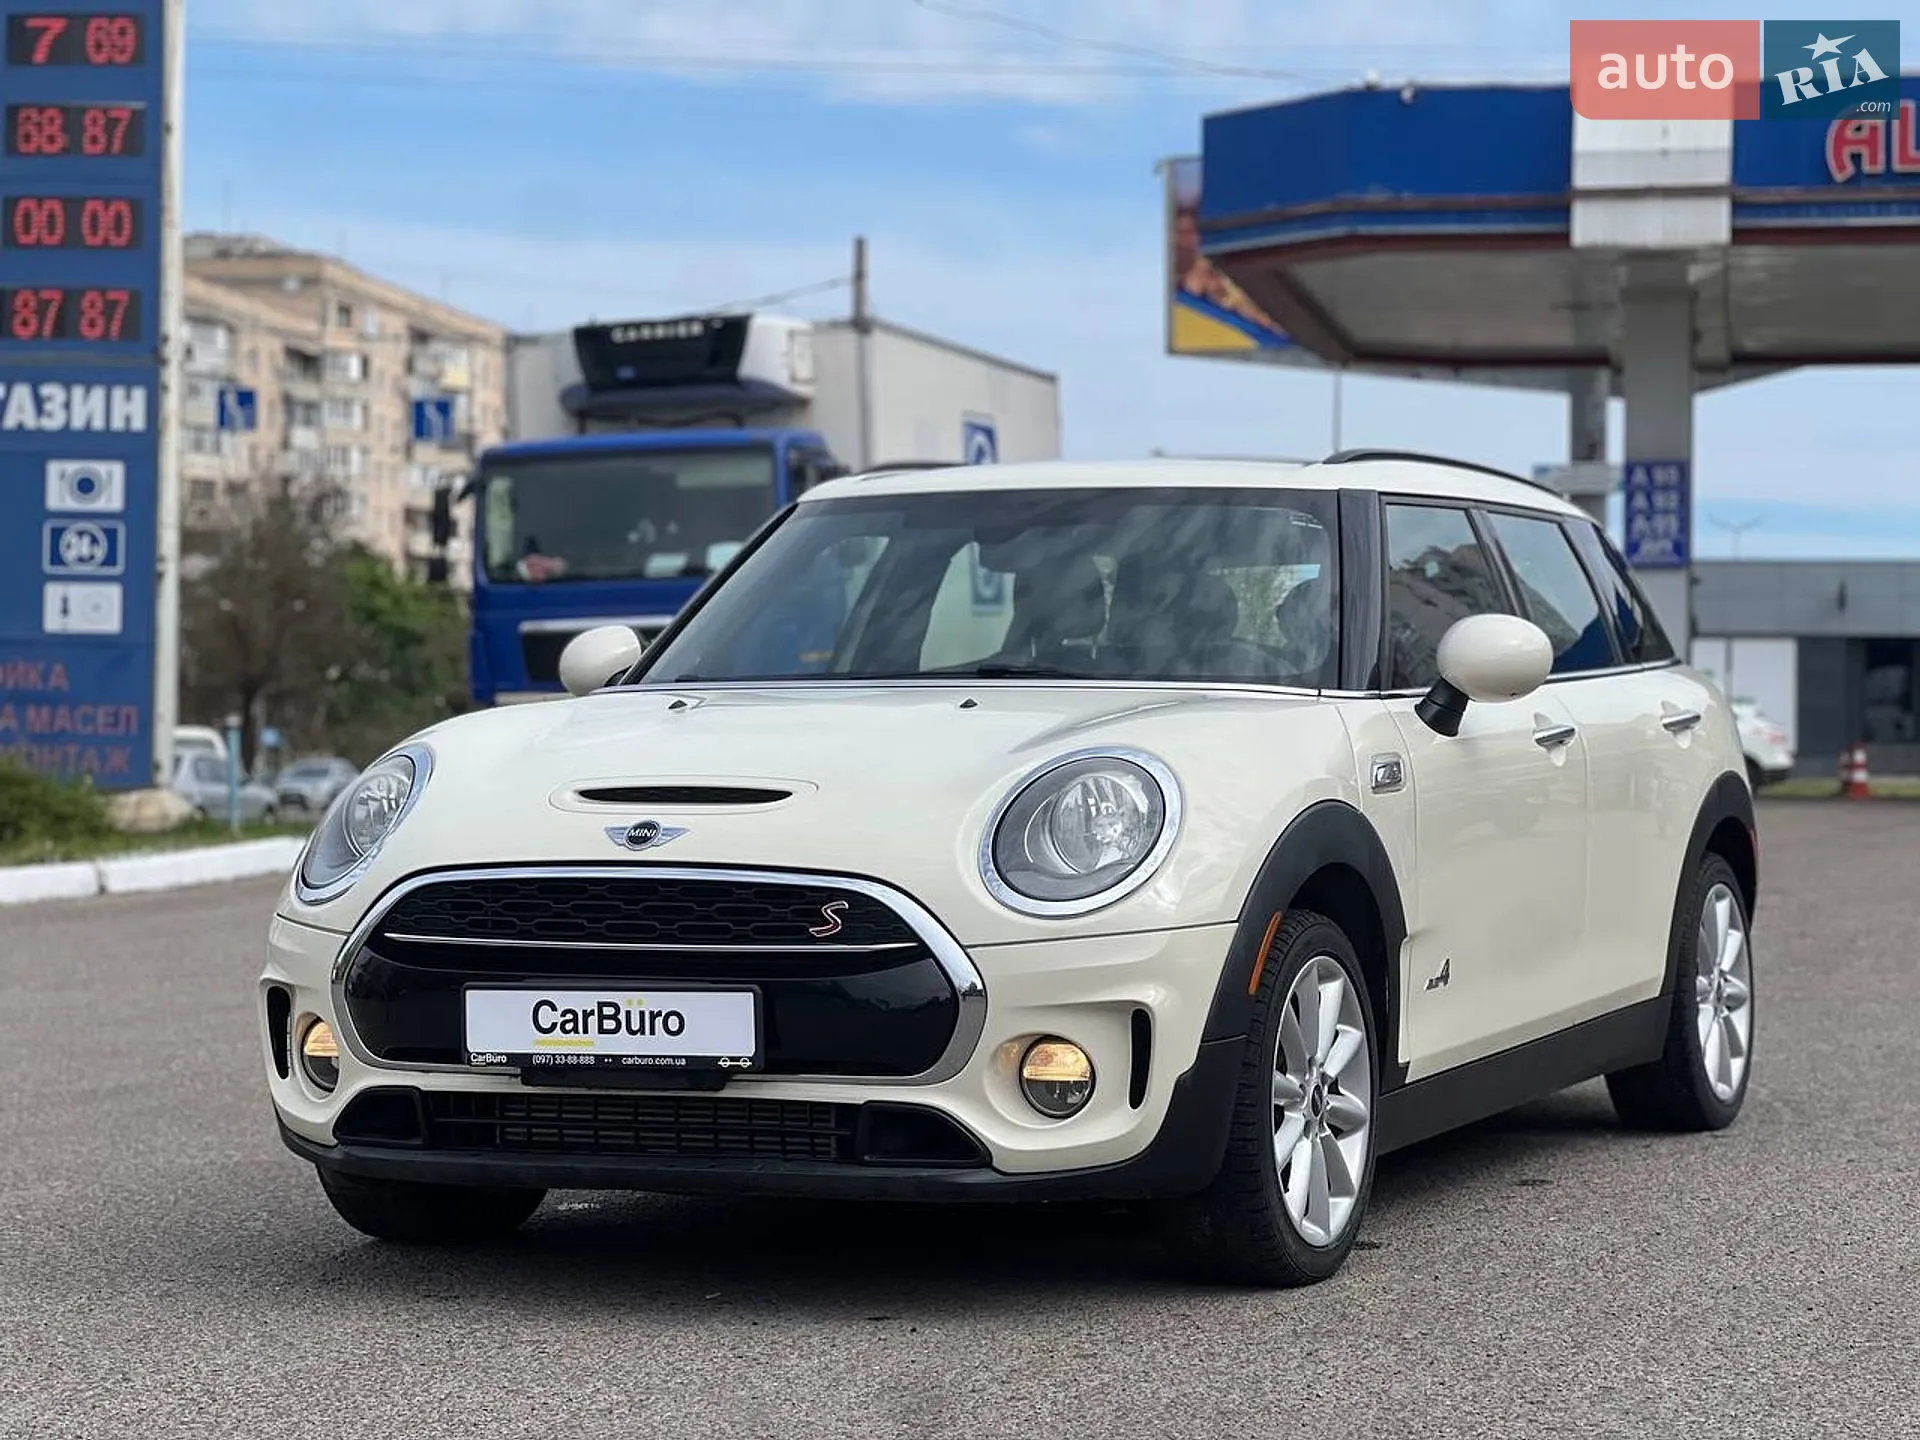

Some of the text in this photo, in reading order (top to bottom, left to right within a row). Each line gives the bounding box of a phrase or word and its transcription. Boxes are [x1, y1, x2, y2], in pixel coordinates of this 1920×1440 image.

[25, 17, 136, 64] 7 69
[82, 107, 132, 154] 87
[14, 198, 133, 247] 00 00
[12, 289, 130, 340] 87 87
[0, 382, 147, 433] АЗИН
[628, 828, 657, 837] MINI
[809, 900, 849, 937] S
[532, 998, 685, 1037] CarBüro
[532, 1054, 553, 1066] (097)
[621, 1055, 686, 1067] carburo.com.ua
